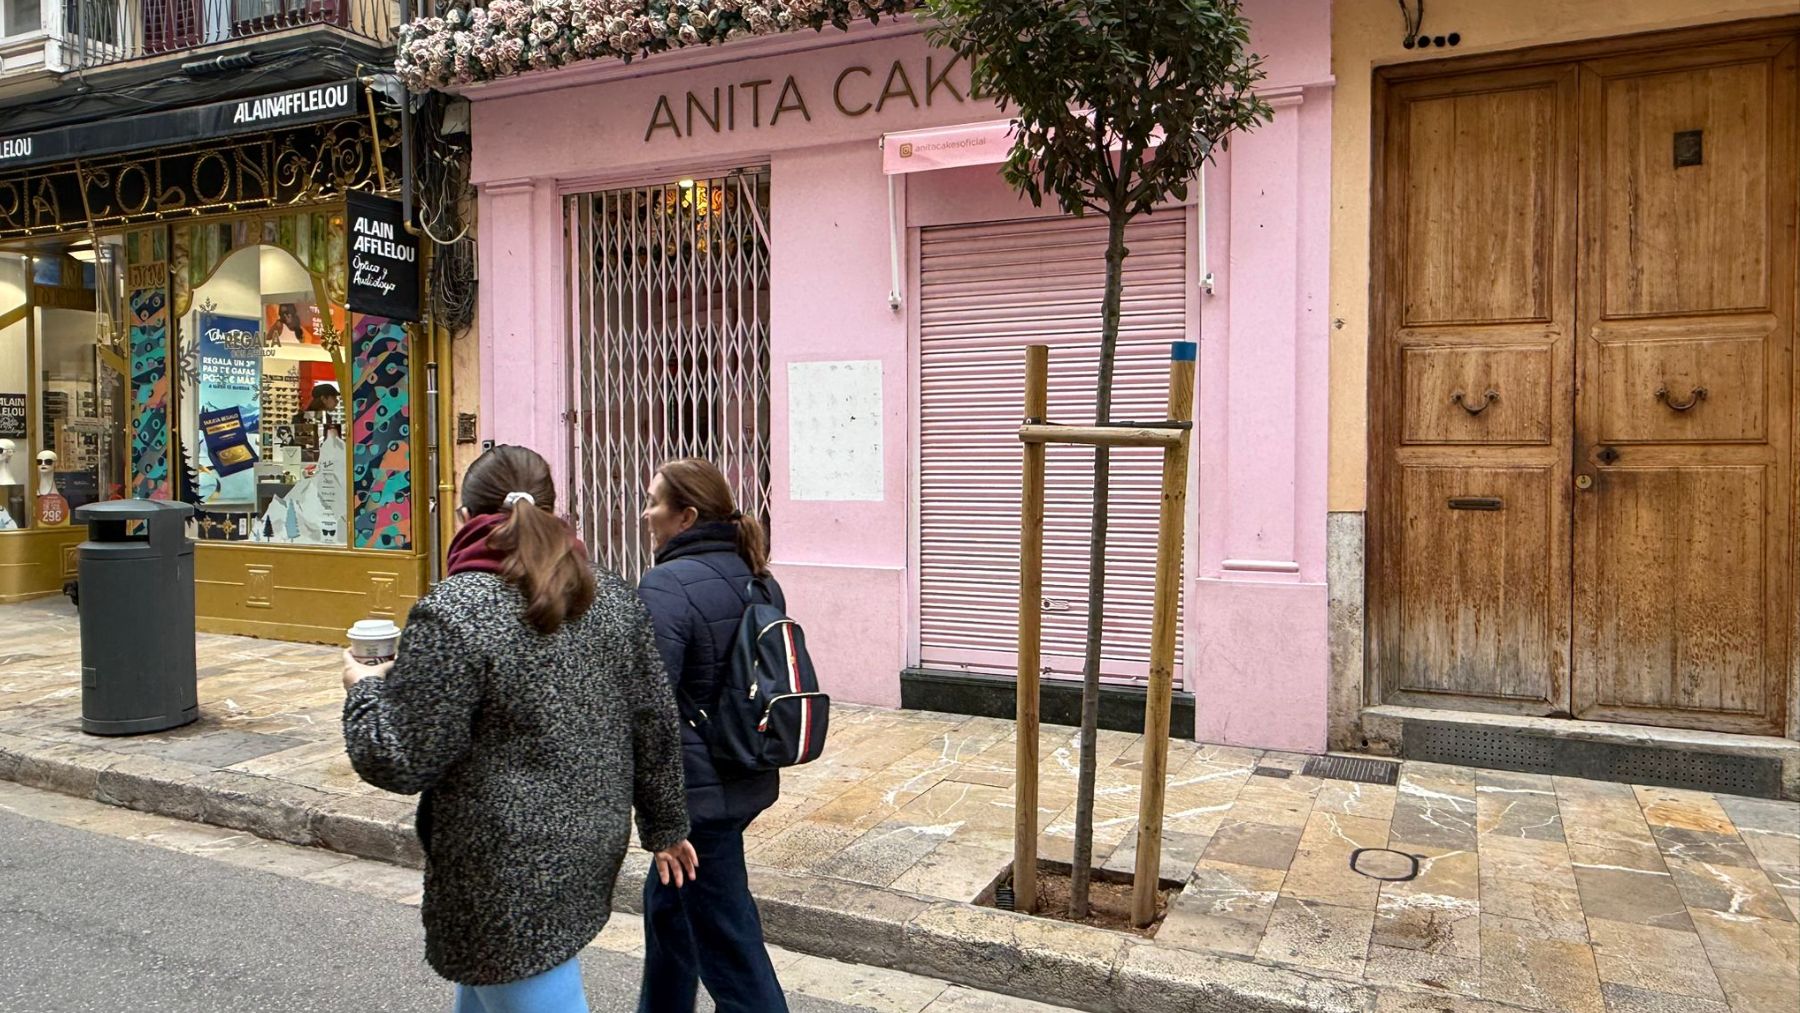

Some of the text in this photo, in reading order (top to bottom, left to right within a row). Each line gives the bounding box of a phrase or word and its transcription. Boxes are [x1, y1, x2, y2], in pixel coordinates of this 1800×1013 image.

[643, 74, 812, 142] ANITA
[914, 136, 986, 152] anitacakesoficial
[353, 216, 394, 240] ALAIN
[353, 235, 415, 262] AFFLELOU
[224, 330, 281, 349] REGALA
[202, 357, 232, 366] REGALA
[202, 365, 218, 373] PAR
[231, 367, 256, 376] GAFAS
[0, 407, 25, 417] ELOU
[42, 510, 62, 522] 29€
